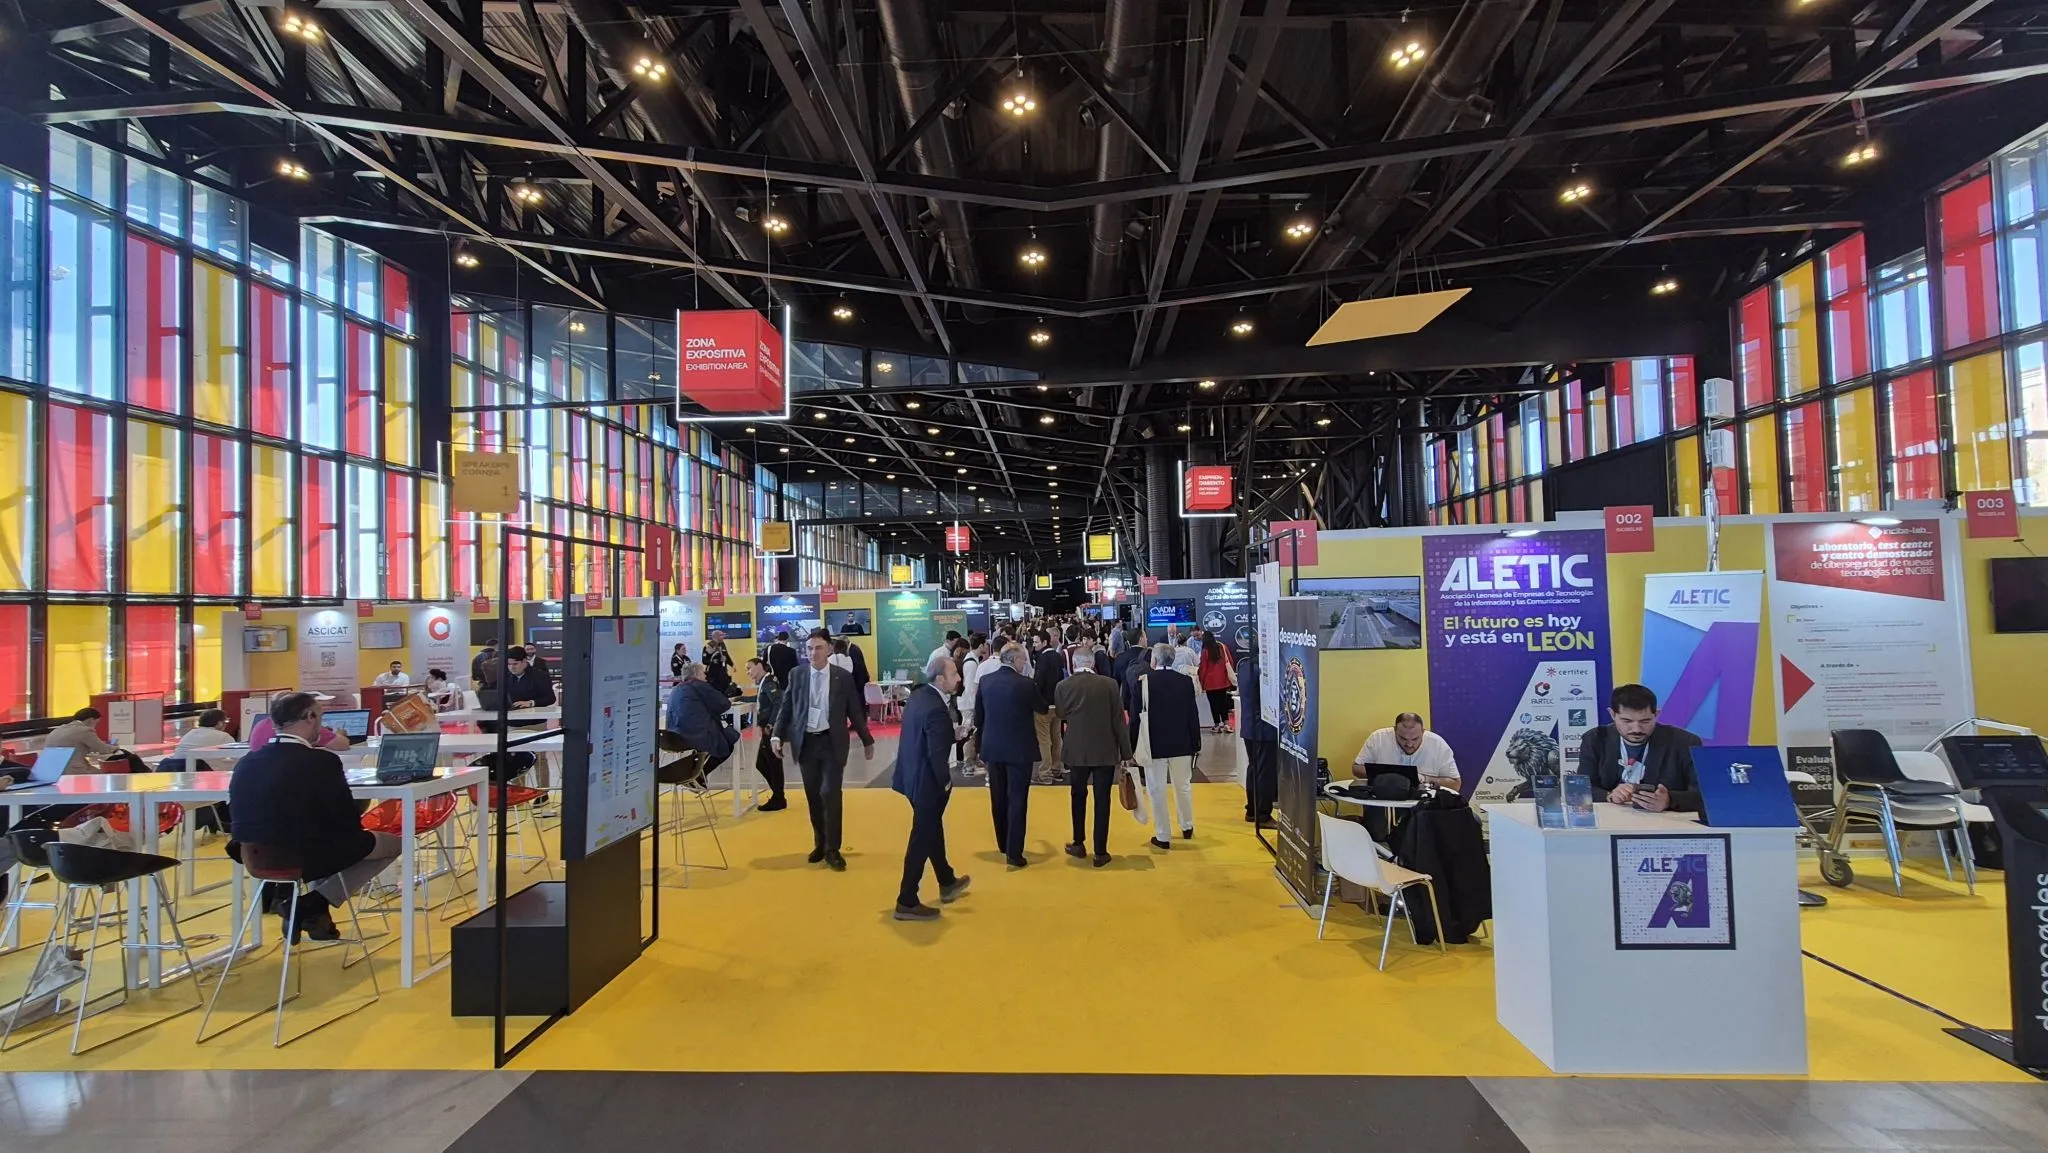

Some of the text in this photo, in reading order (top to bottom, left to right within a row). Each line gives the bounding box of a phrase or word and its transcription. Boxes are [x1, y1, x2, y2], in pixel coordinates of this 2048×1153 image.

[686, 339, 716, 348] ZONA
[686, 349, 747, 360] EXPOSITIVA
[686, 363, 727, 372] EXHIBITION
[502, 486, 510, 496] 1
[1977, 498, 2005, 509] 003
[1616, 514, 1643, 525] 002
[1813, 540, 1934, 551] Laboratorio, test center
[1821, 549, 1934, 562] y centro demostrador
[1811, 558, 1935, 570] de ciberseguridad de nuevas
[1440, 554, 1594, 592] ALETIC
[1892, 568, 1904, 576] de
[1905, 567, 1935, 576] INCIBE
[1441, 592, 1476, 600] Asociación
[1513, 591, 1545, 599] Empresas
[1670, 589, 1731, 605] ALETIC
[1472, 599, 1511, 607] Información
[1444, 614, 1582, 630] El futuro es hoy
[308, 626, 349, 636] ASCICAT
[1445, 627, 1595, 652] y está en LEÓN
[1637, 857, 1706, 873] ALETIC
